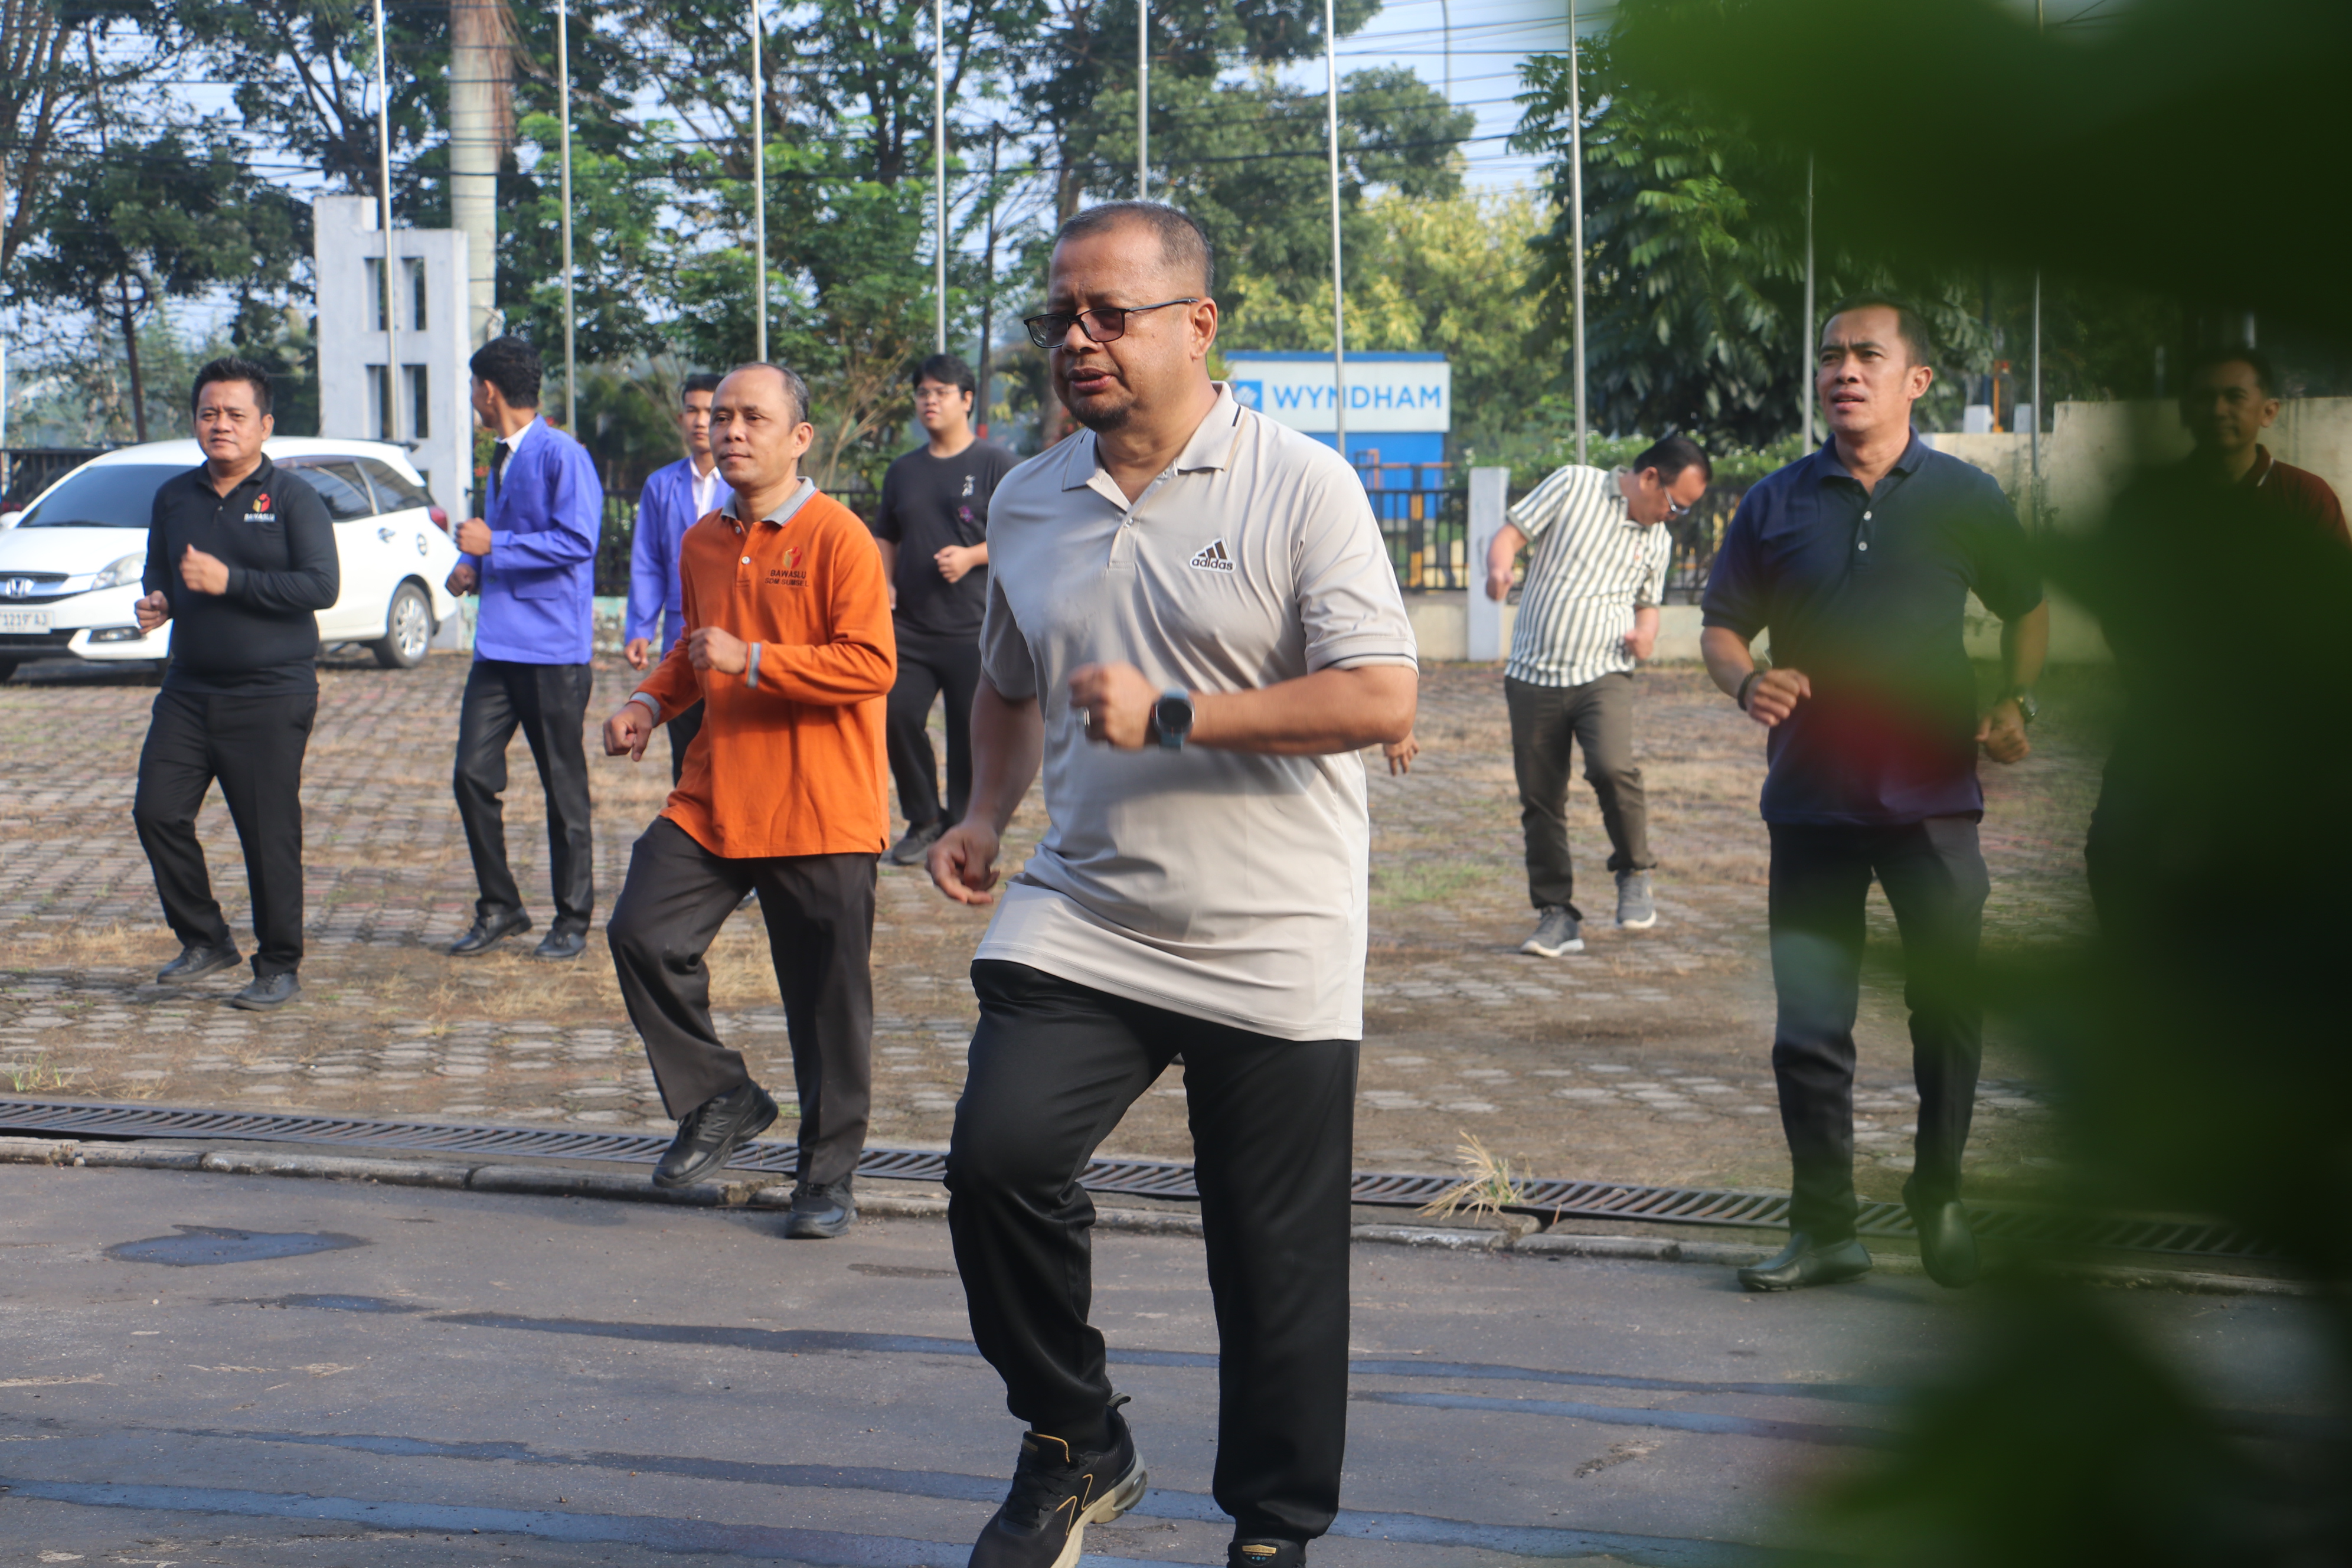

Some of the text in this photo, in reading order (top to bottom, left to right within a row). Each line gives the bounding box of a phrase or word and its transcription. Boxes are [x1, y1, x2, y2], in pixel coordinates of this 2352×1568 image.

[1273, 386, 1441, 409] WYNDHAM
[1192, 558, 1233, 570] adidas
[770, 570, 806, 579] BAWASLU
